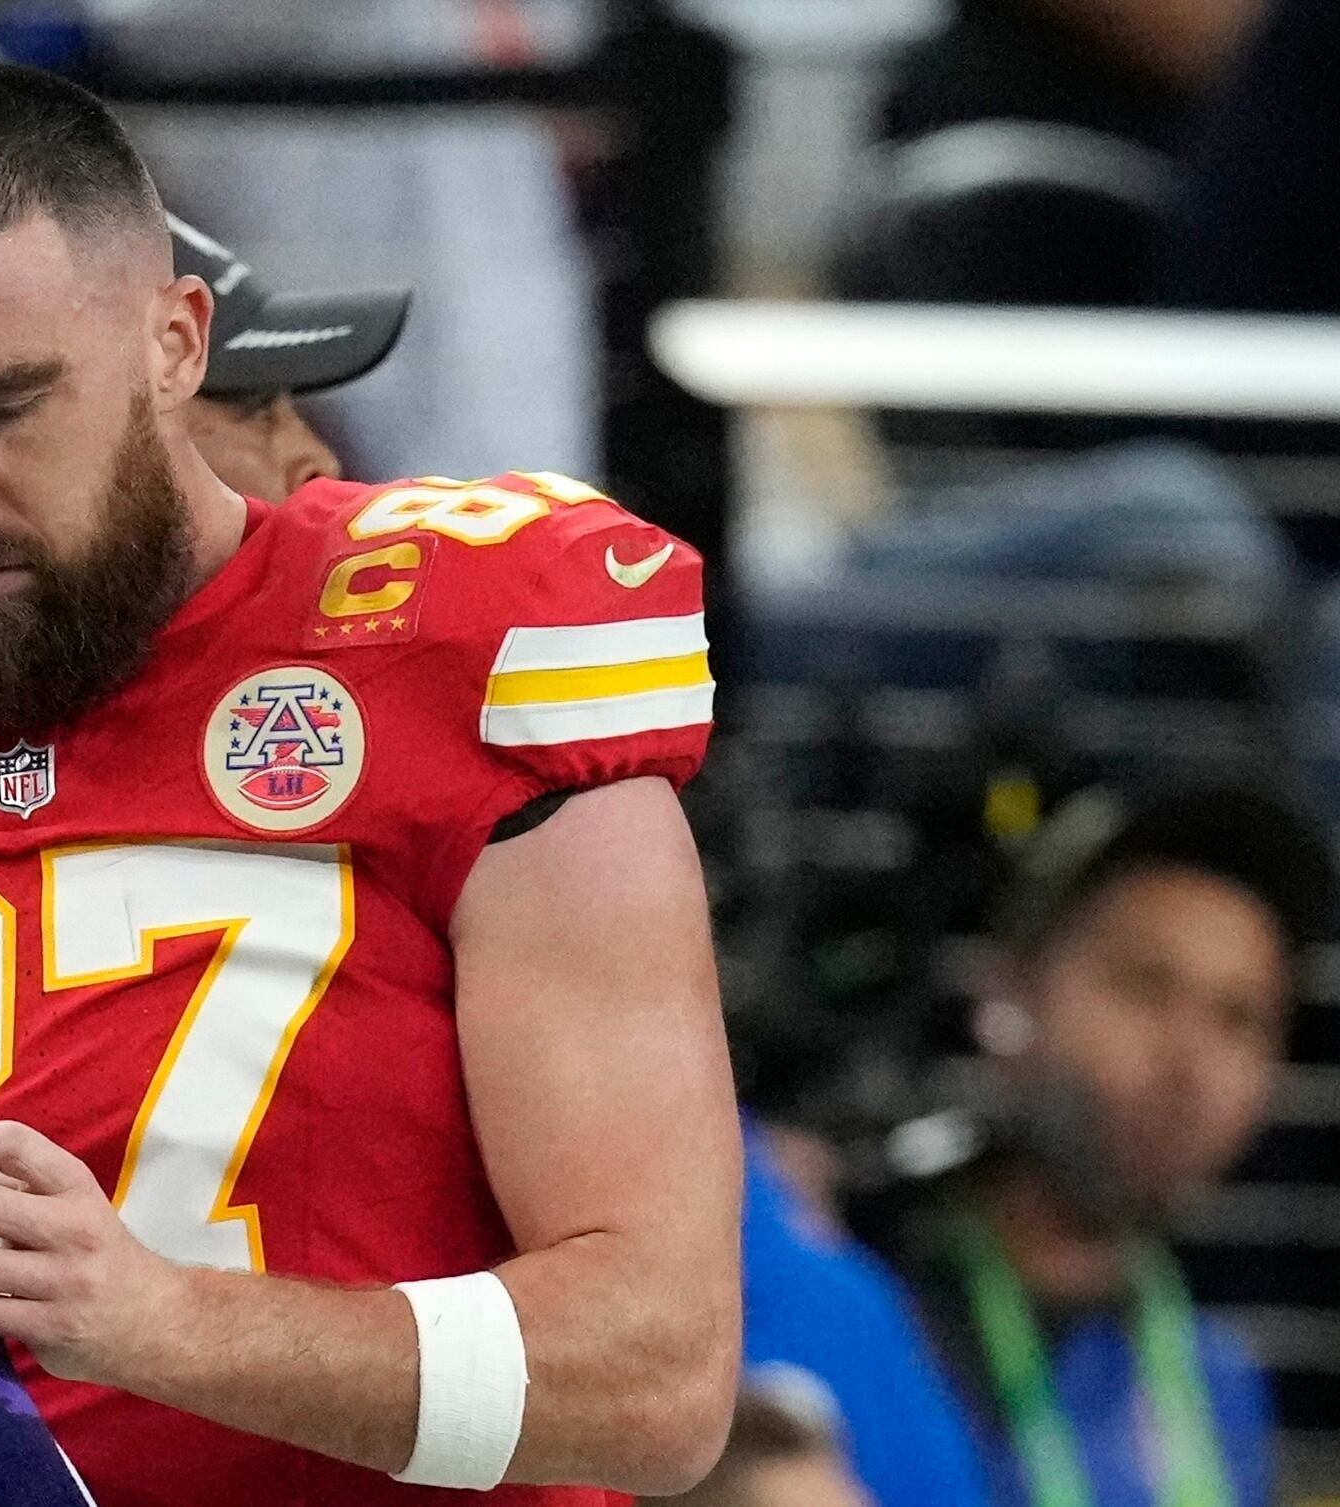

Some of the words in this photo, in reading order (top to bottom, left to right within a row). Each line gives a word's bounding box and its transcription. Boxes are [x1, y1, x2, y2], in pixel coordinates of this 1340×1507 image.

[319, 541, 421, 618] C
[226, 683, 343, 770] A
[3, 770, 45, 801] NFL
